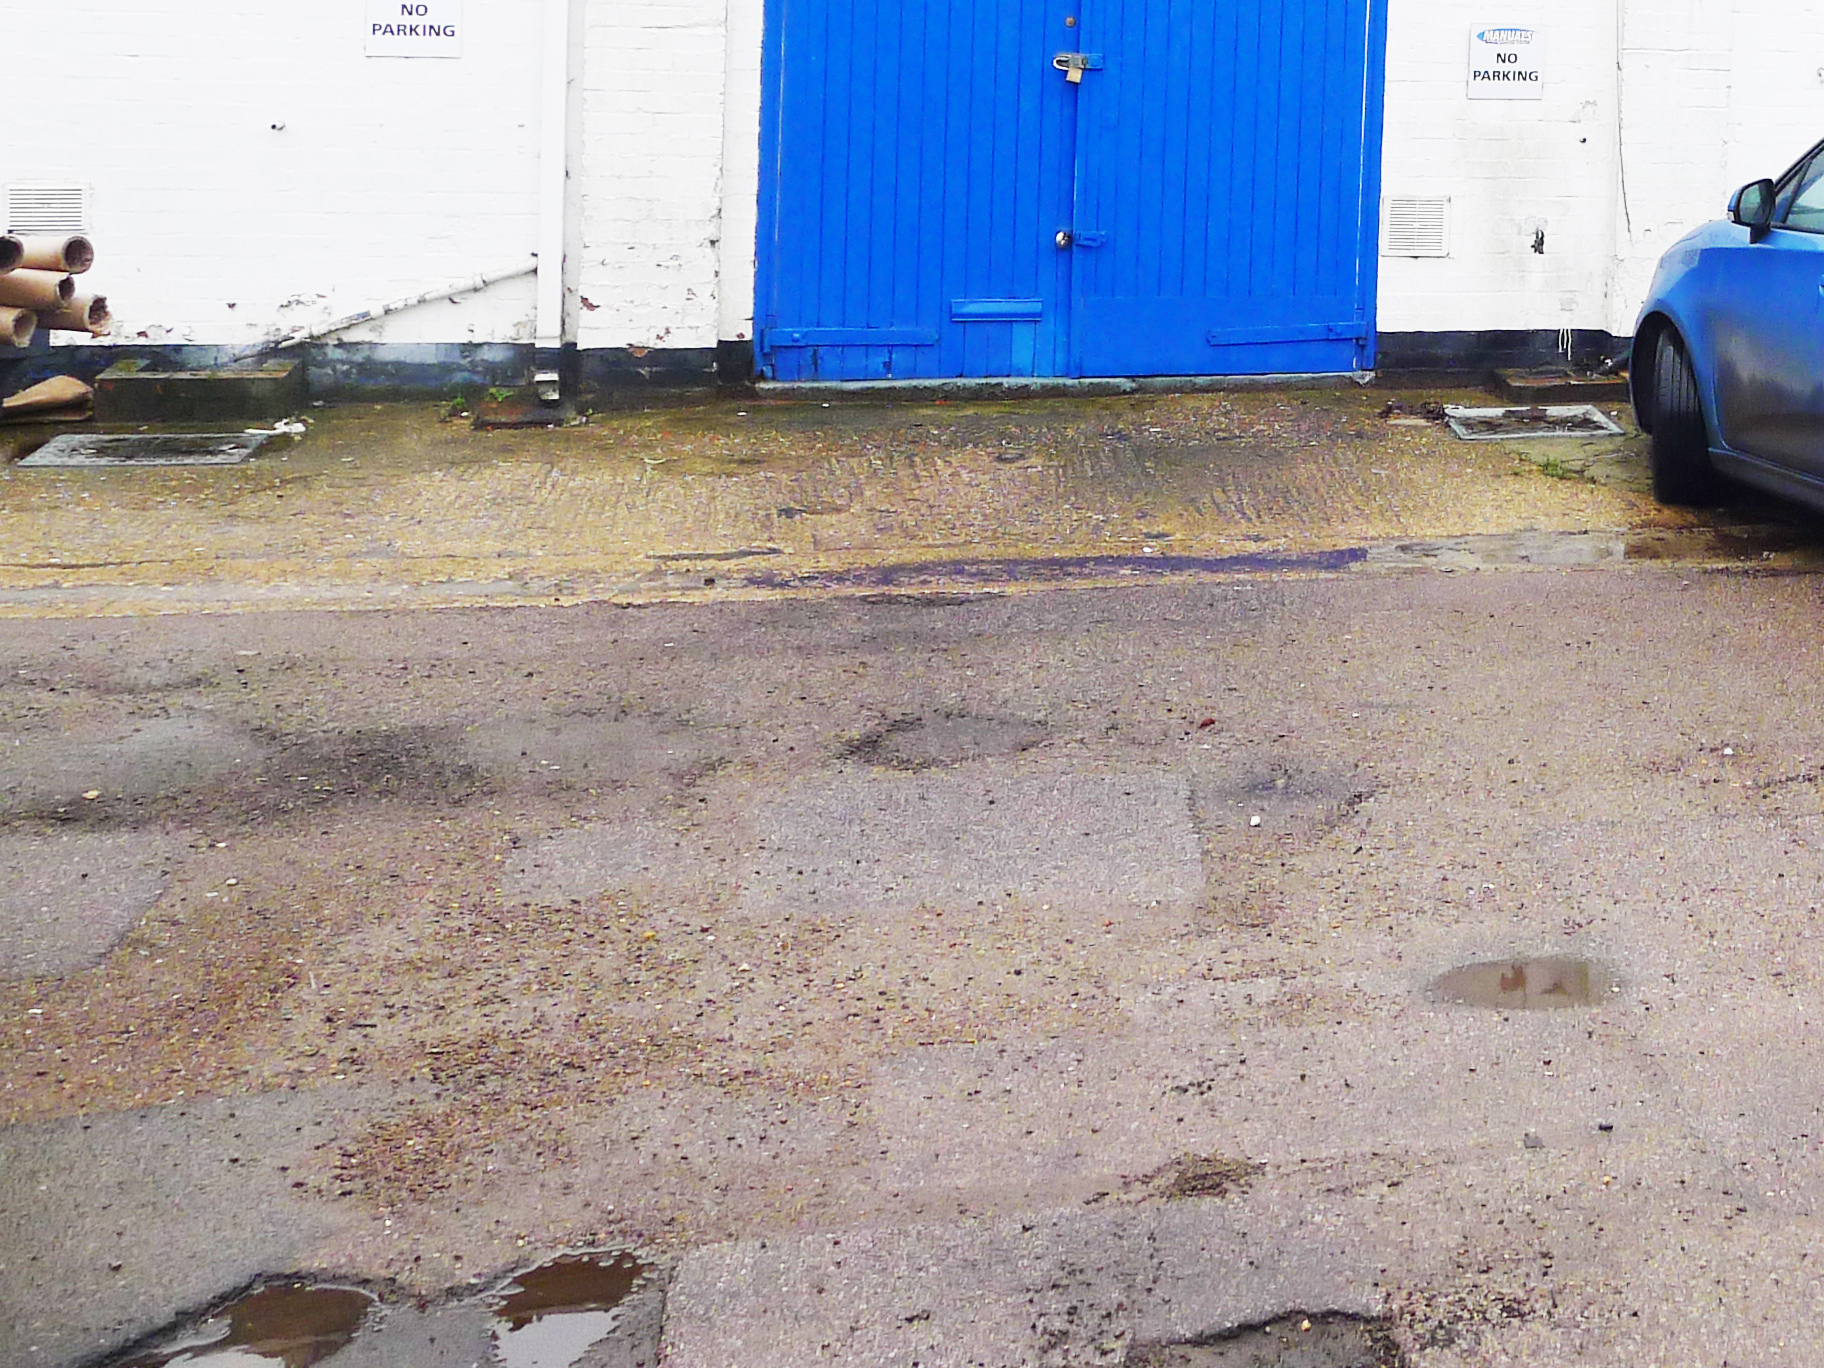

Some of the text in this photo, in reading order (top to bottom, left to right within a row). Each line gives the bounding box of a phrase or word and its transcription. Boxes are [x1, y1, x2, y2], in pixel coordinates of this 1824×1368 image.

[401, 3, 428, 17] NO
[372, 23, 455, 37] PARKING
[1496, 52, 1518, 64] NO
[1473, 70, 1539, 82] PARKING
